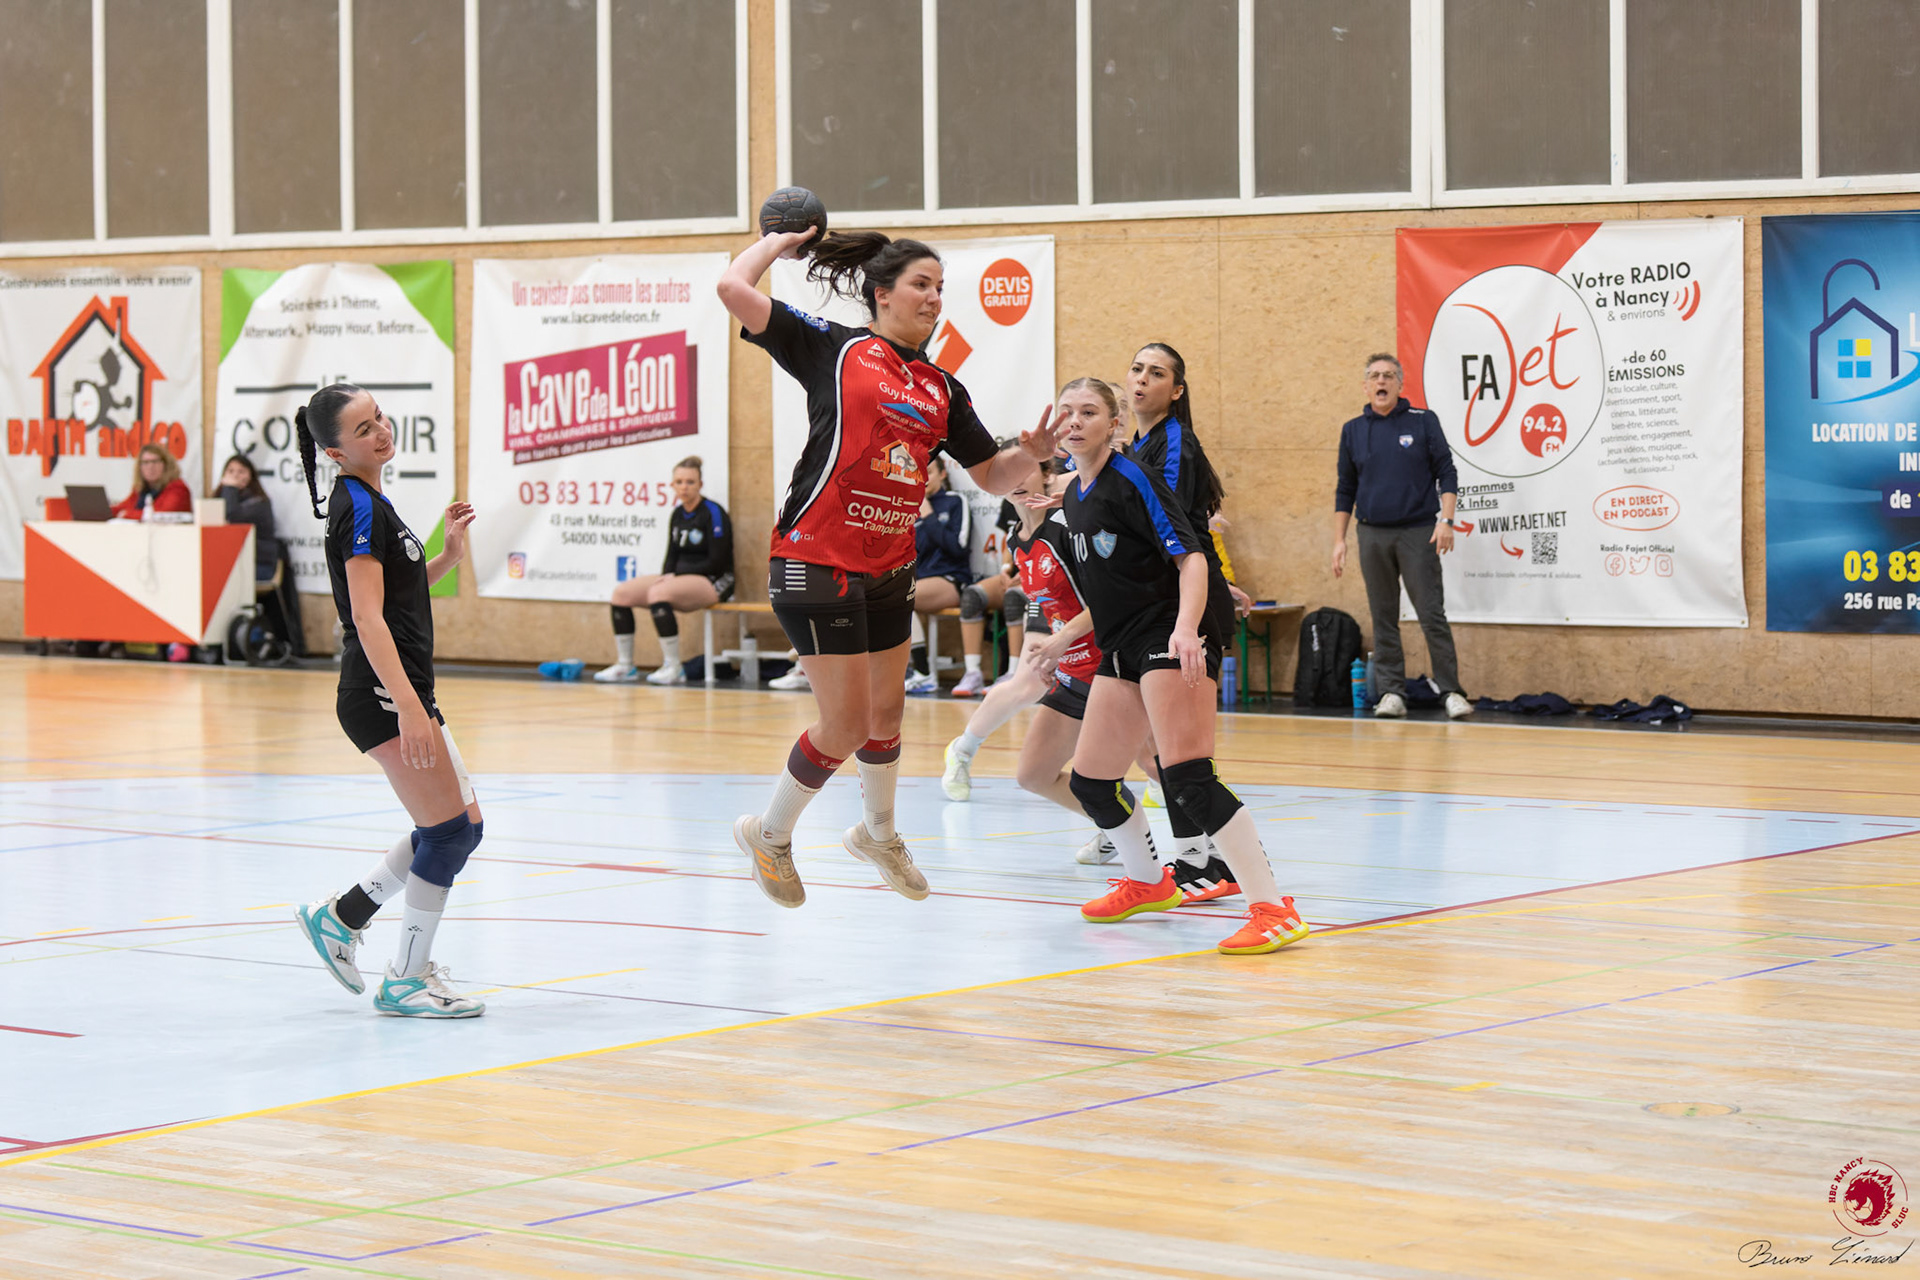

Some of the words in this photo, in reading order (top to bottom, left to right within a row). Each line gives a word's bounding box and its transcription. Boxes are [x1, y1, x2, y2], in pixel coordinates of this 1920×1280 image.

[70, 276, 121, 288] ensemble
[126, 277, 154, 287] votre
[158, 275, 192, 287] avenir
[1572, 272, 1625, 290] Votre
[1631, 261, 1691, 284] RADIO
[512, 281, 527, 306] Un
[530, 281, 568, 306] caviste
[569, 283, 589, 307] pas
[593, 282, 633, 304] comme
[636, 279, 652, 303] les
[655, 278, 691, 304] autres
[983, 276, 1030, 295] DEVIS
[281, 298, 328, 313] Soirées
[984, 294, 1030, 308] GRATUIT
[1595, 292, 1607, 308] à
[1614, 290, 1669, 308] Nancy
[542, 310, 660, 325] www.lacavedeleon.fr
[1607, 310, 1616, 321] &
[1620, 308, 1666, 321] environs
[305, 322, 342, 337] Happy
[346, 322, 375, 335] Hour,
[1650, 349, 1667, 361] 60
[1608, 364, 1685, 382] ÉMISSIONS
[1623, 383, 1649, 393] locale,
[1650, 382, 1678, 392] culture,
[879, 381, 899, 400] Guy
[901, 391, 938, 416] Hoquet
[1605, 395, 1660, 407] divertissement,
[1661, 393, 1682, 404] sport,
[1638, 406, 1678, 417] littérature,
[619, 410, 676, 430] SPIRITUEUX
[1523, 415, 1562, 433] 94.2
[1646, 419, 1679, 428] sciences,
[1600, 434, 1640, 445] patrimoine,
[1641, 429, 1693, 442] engagement,
[1812, 423, 1889, 442] LOCATION
[1894, 422, 1917, 442] DE
[1546, 443, 1560, 452] FM
[519, 481, 549, 505] 03
[556, 481, 580, 504] 83
[589, 482, 615, 505] 17
[622, 481, 650, 506] 84
[1611, 497, 1625, 508] EN
[1629, 494, 1664, 507] DIRECT
[1890, 490, 1911, 509] de
[892, 496, 904, 507] LE
[1457, 498, 1465, 510] &
[1469, 496, 1499, 510] Infos
[1603, 510, 1618, 520] EN
[1622, 506, 1669, 519] PODCAST
[564, 516, 583, 527] rue
[588, 514, 627, 528] Marcel
[631, 515, 656, 529] Brot
[1479, 511, 1567, 535] WWW.FAJET.NET
[601, 533, 641, 546] NANCY
[1600, 544, 1623, 552] Radio
[1625, 544, 1647, 555] Fajet
[1648, 544, 1675, 554] Officiel
[1843, 550, 1879, 582] 03
[1888, 550, 1920, 582] 83
[1844, 593, 1873, 610] 256
[1877, 596, 1903, 610] rue
